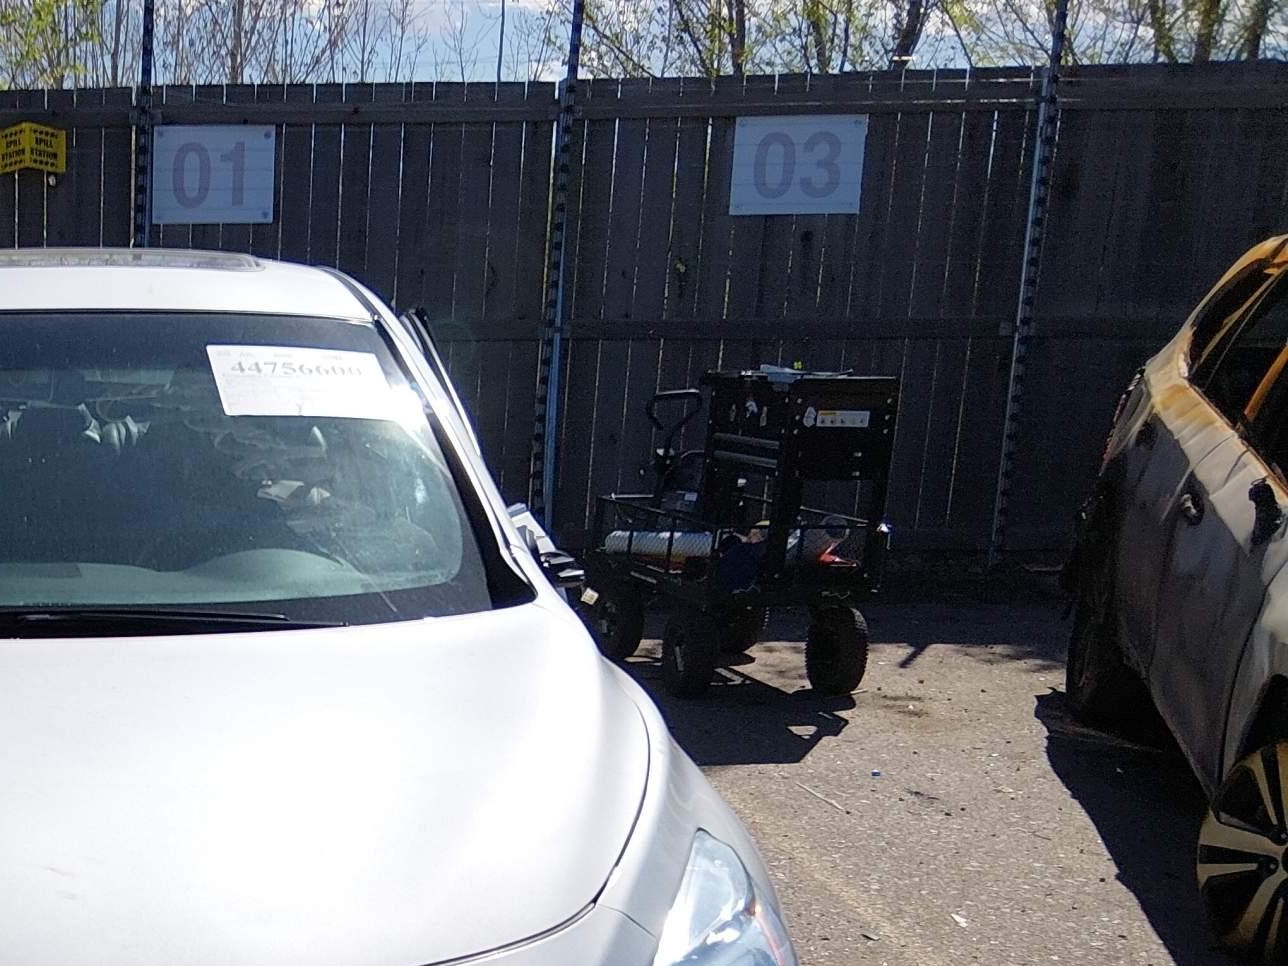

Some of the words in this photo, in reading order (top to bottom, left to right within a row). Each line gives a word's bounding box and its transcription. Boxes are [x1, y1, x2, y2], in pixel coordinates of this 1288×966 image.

[1, 148, 26, 161] STATION
[30, 147, 58, 161] STATION
[753, 131, 842, 200] 03
[172, 141, 246, 209] 01
